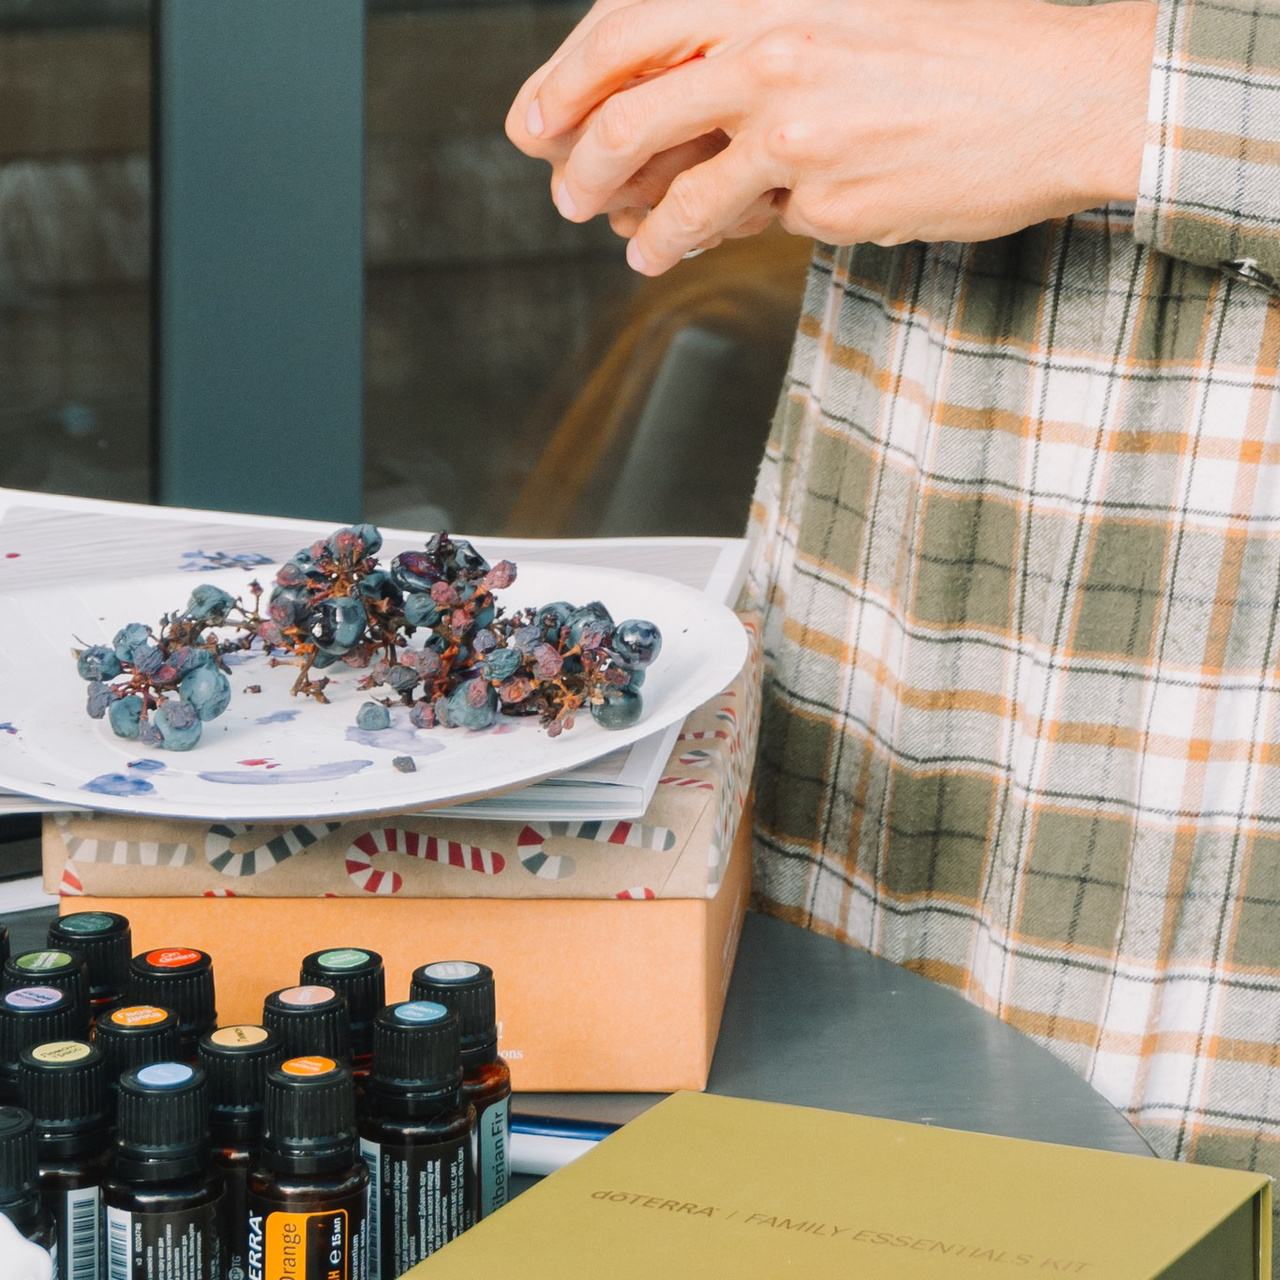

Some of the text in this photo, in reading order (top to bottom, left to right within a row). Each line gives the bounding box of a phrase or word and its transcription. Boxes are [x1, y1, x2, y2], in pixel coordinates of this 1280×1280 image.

[491, 1112, 505, 1213] iberian Fir
[331, 1235, 341, 1247] 15
[744, 1213, 852, 1237] FAMILY
[852, 1229, 1034, 1266] ESSENTIALS
[1039, 1258, 1093, 1274] KIT
